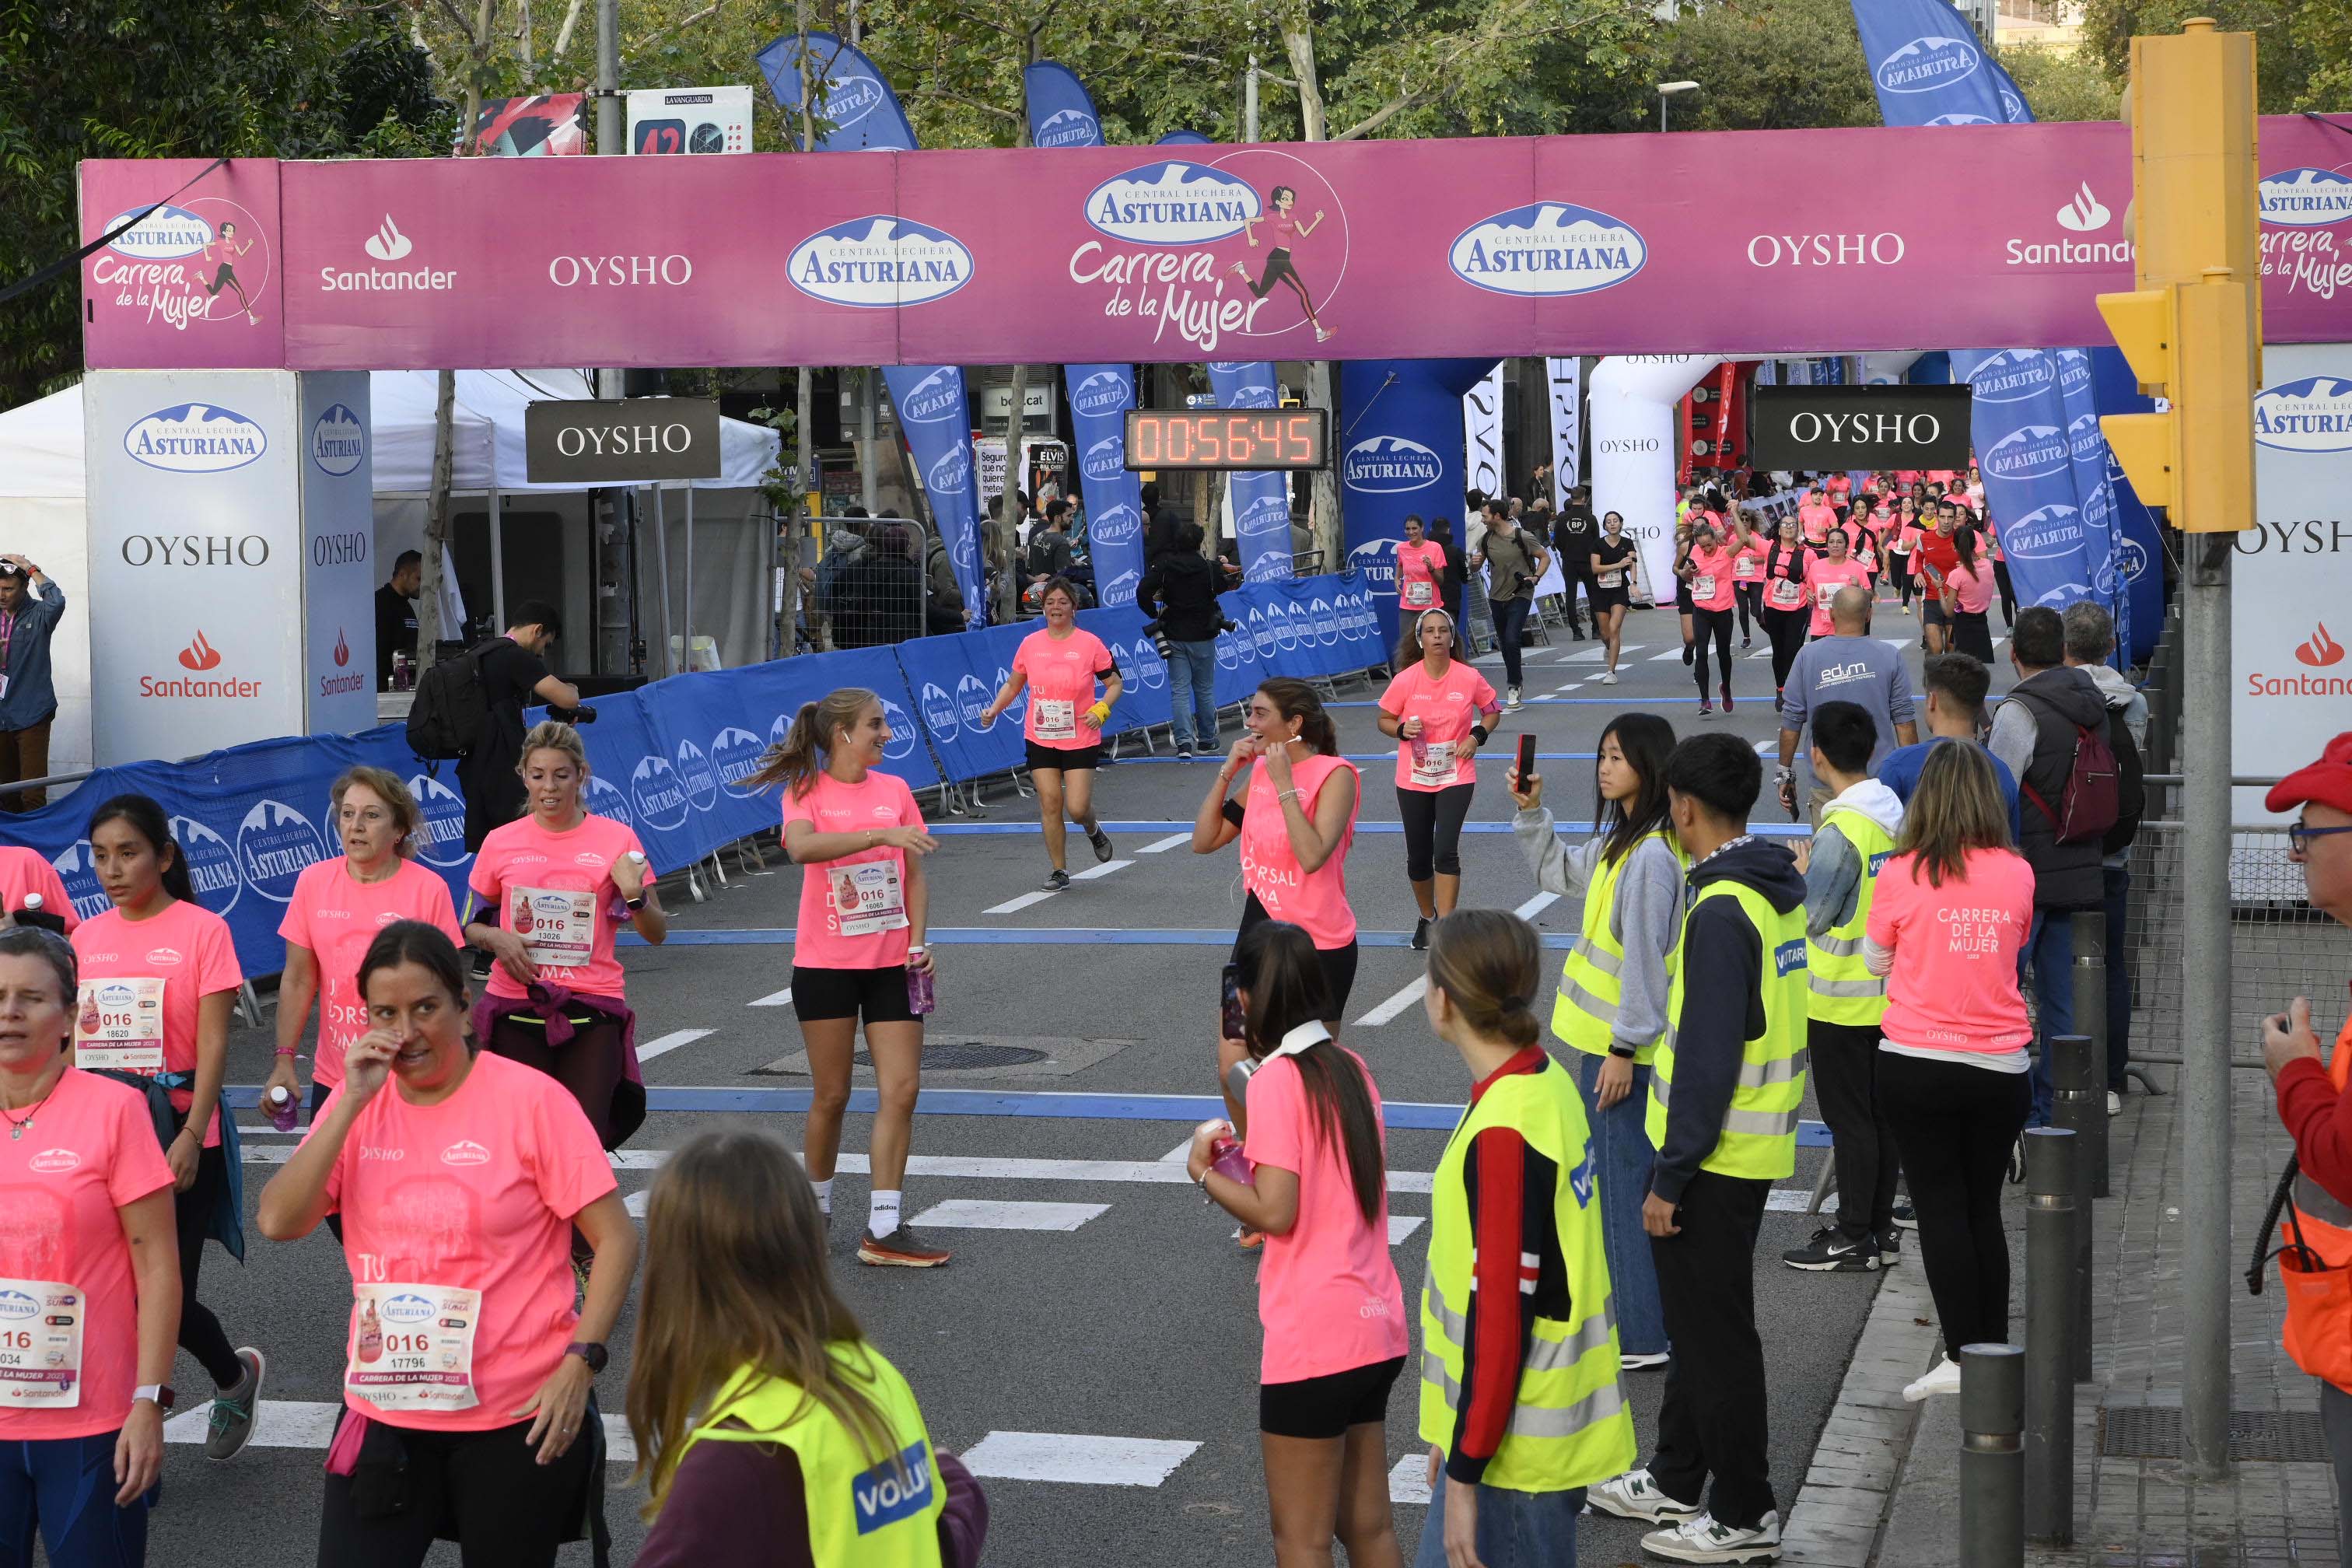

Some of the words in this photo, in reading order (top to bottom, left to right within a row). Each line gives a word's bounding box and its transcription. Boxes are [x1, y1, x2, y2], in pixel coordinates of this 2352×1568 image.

[1125, 190, 1181, 198] CENTRAL
[1186, 189, 1242, 198] LECHERA
[1098, 193, 1248, 224] ASTURIANA
[111, 225, 205, 245] ASTURIANA
[1494, 234, 1556, 245] CENTRAL
[1562, 233, 1625, 243] LECHERA
[829, 247, 888, 257] CENTRAL
[894, 247, 953, 256] LECHERA
[1464, 238, 1633, 273] ASTURIANA
[1747, 233, 1906, 267] OYSHO
[93, 256, 184, 286] Carrera
[549, 254, 692, 287] OYSHO
[801, 250, 960, 284] ASTURIANA
[1069, 240, 1215, 284] Carrera
[2278, 254, 2291, 275] la
[321, 267, 457, 291] Santander
[116, 289, 133, 306] de
[137, 292, 149, 306] la
[146, 283, 219, 330] Mujer
[1105, 286, 1132, 316] de
[1138, 285, 1157, 316] la
[1153, 278, 1269, 352] Mujer
[1138, 418, 1311, 460] 00:56:45
[1790, 412, 1940, 444] OYSHO
[135, 429, 257, 455] ASTURIANA
[317, 431, 361, 457] ASTURIANA
[557, 424, 691, 457] OYSHO
[1600, 438, 1659, 454] OYSHO
[1041, 452, 1063, 461] ELVIS
[982, 465, 995, 475] que
[1346, 459, 1435, 481] ASTURIANA
[121, 534, 270, 566] OYSHO
[313, 532, 366, 567] OYSHO
[1822, 663, 1866, 681] edym
[140, 676, 262, 698] Santander
[320, 671, 364, 698] Santander
[252, 835, 280, 848] CENTRAL
[282, 829, 311, 842] LECHERA
[245, 842, 320, 882] ASTURIANA
[188, 861, 237, 894] URIANA
[861, 889, 884, 901] 016
[536, 919, 565, 930] 016
[1937, 908, 2011, 923] CARRERA
[1952, 923, 1972, 937] DE
[1978, 923, 1997, 937] LA
[1949, 938, 1999, 953] MUJER
[103, 1013, 131, 1025] 016
[1926, 1030, 1968, 1044] OYSHO
[358, 1253, 387, 1282] TU
[387, 1334, 429, 1352] 016
[391, 1357, 425, 1368] 17796
